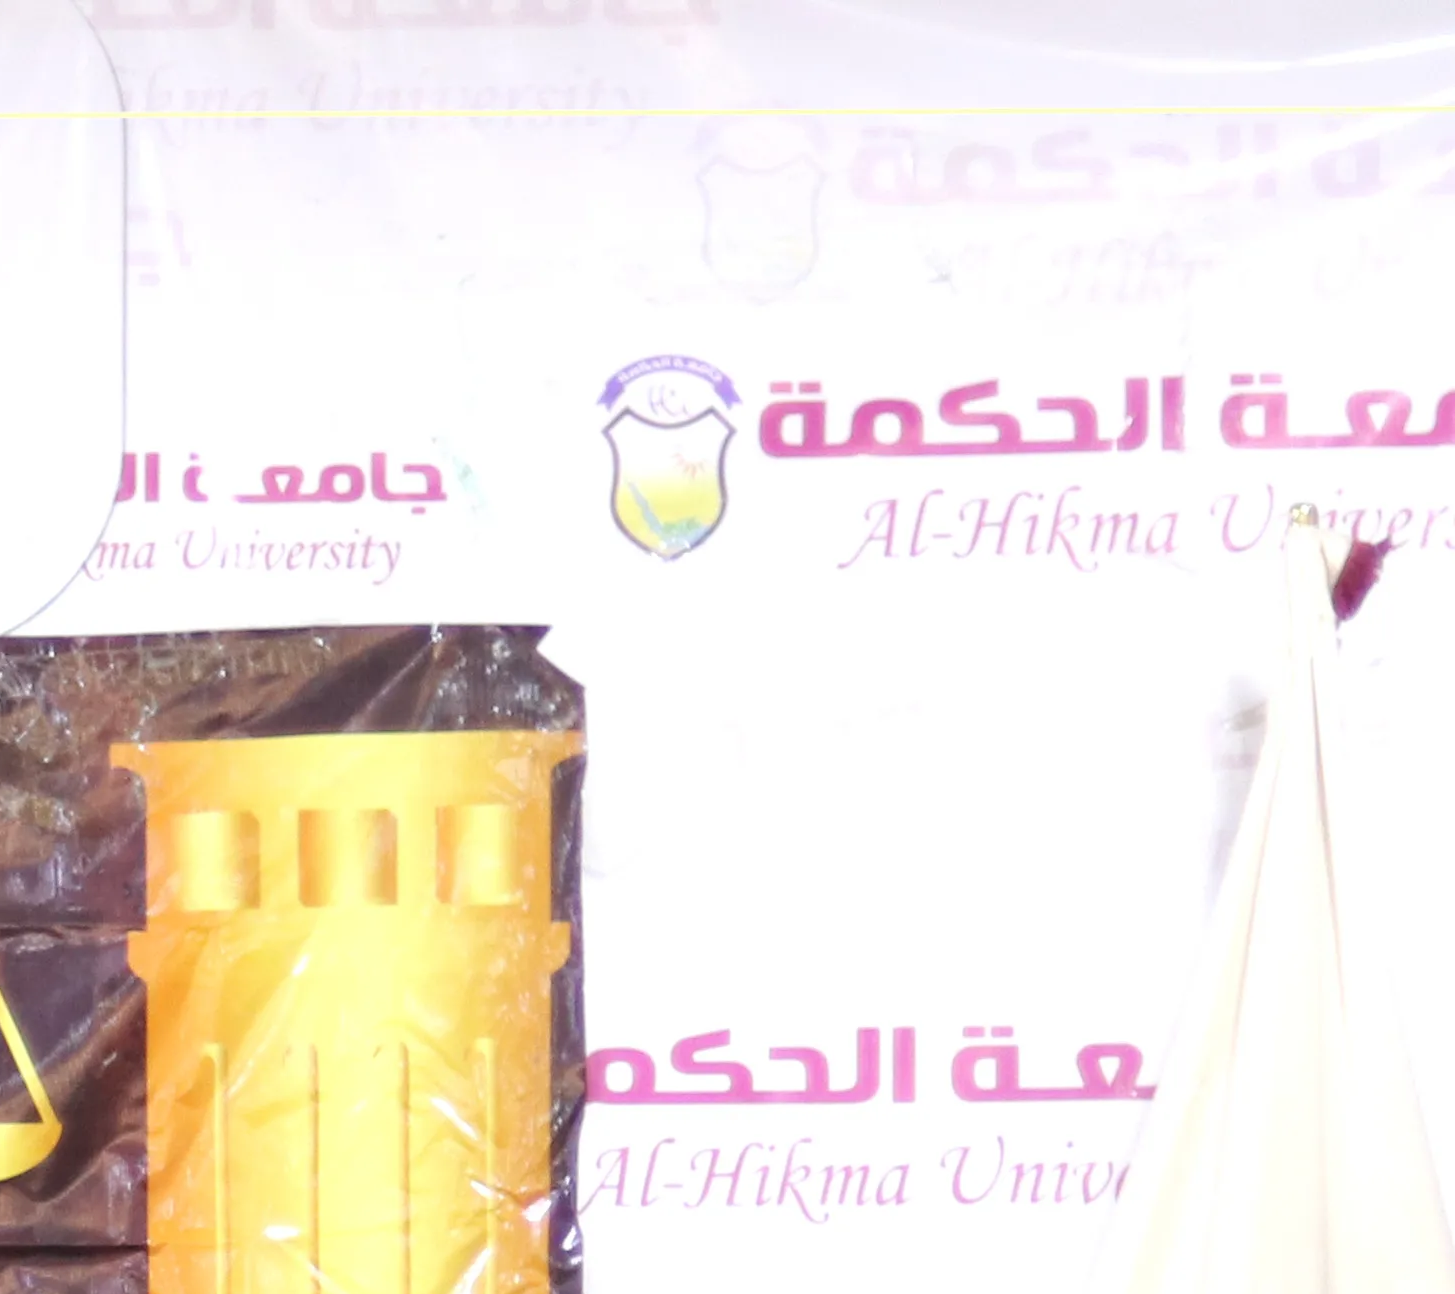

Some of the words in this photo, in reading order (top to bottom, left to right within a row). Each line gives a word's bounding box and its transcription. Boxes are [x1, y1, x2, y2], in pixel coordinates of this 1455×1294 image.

[758, 376, 1186, 459] الحكمة
[837, 484, 1179, 574] Al-Hikma
[585, 1026, 917, 1106] الحكم
[577, 1137, 911, 1224] Al-Hikma
